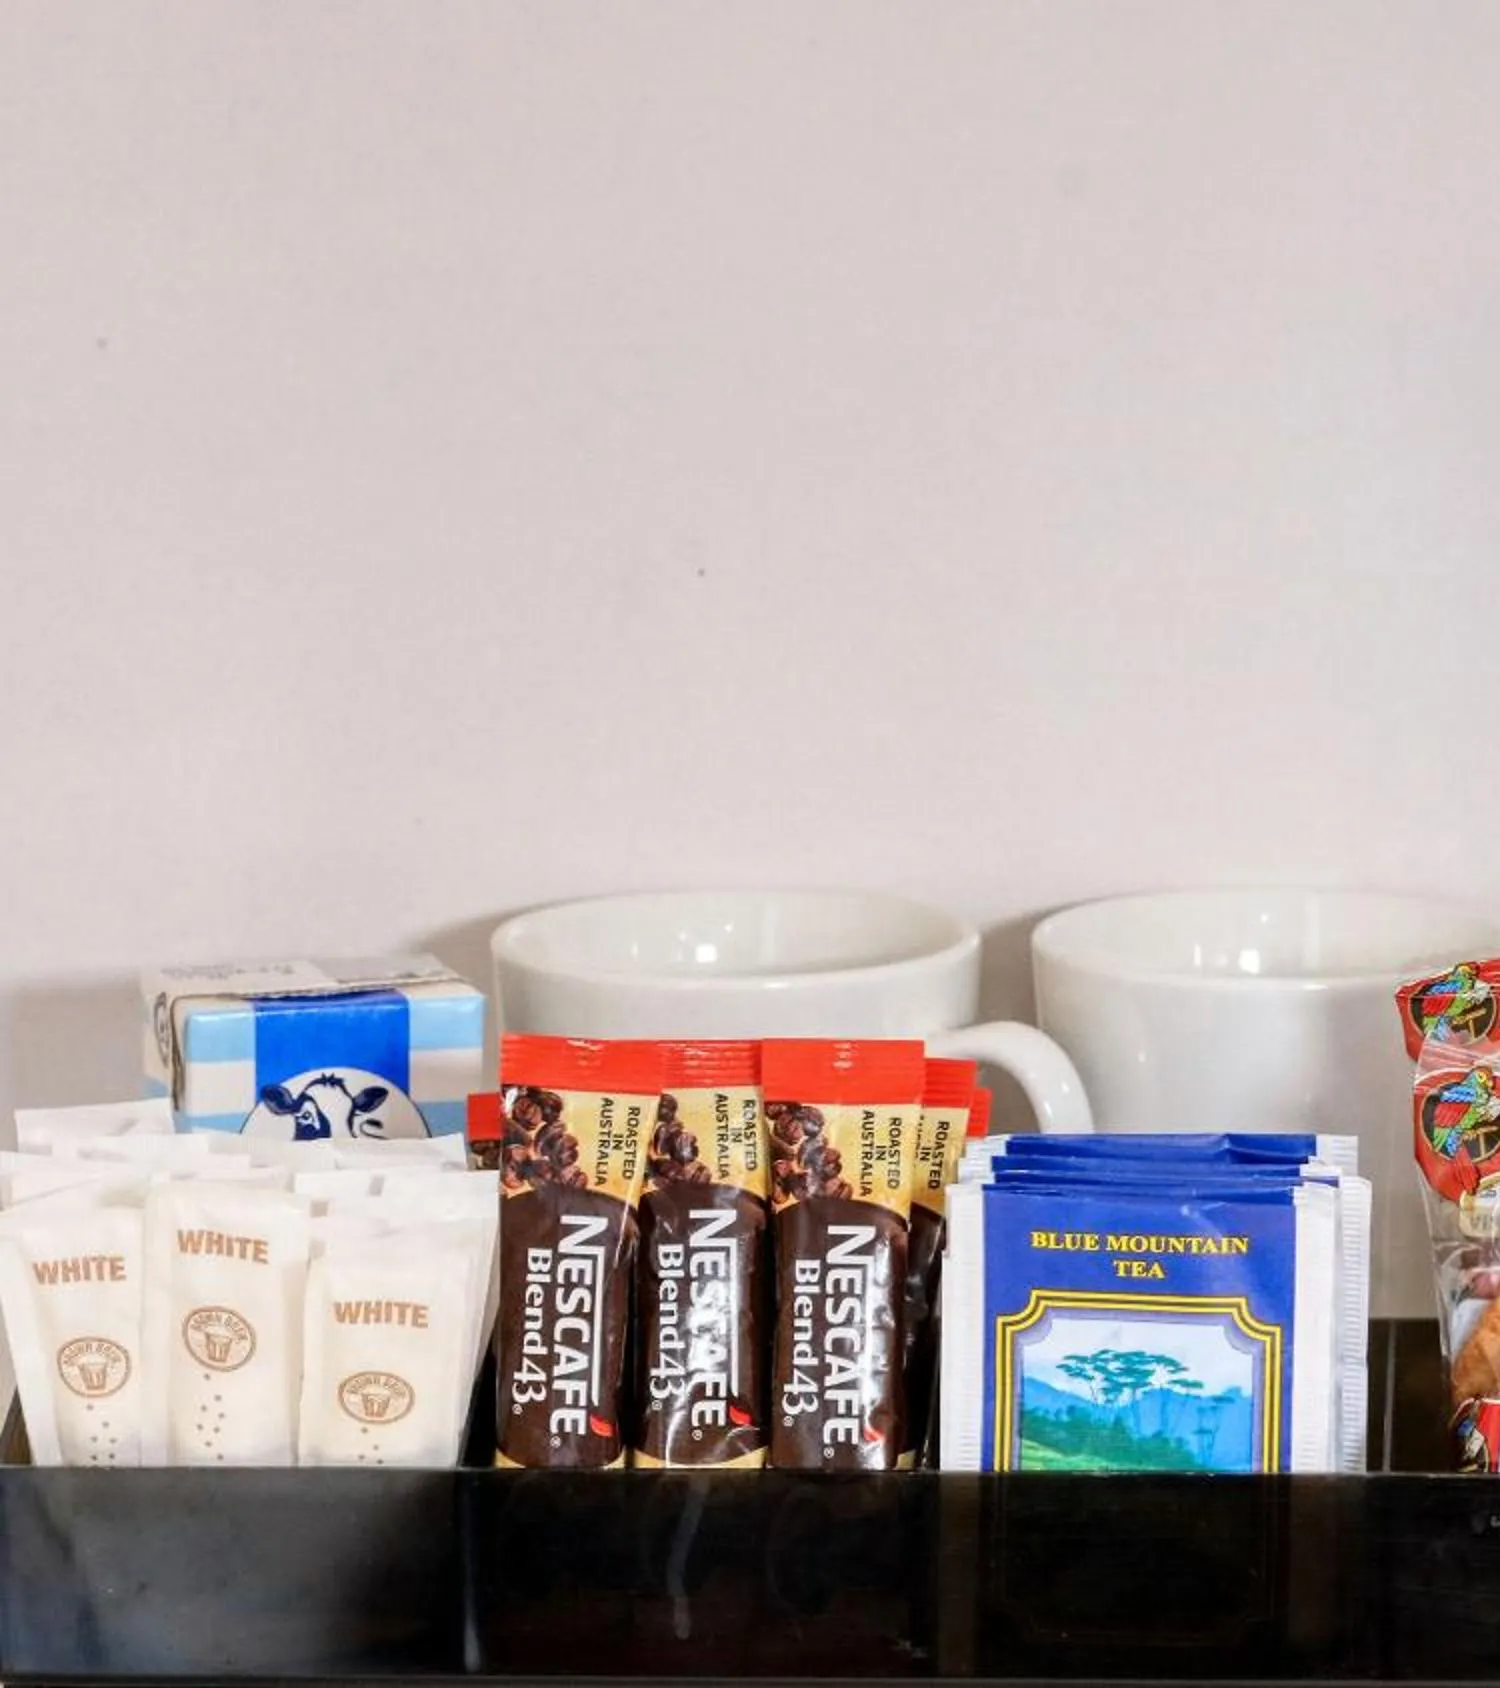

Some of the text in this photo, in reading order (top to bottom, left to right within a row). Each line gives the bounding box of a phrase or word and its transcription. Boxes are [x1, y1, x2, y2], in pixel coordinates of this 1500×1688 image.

[594, 1097, 614, 1187] AUSTRALIA
[611, 1133, 625, 1151] IN
[621, 1105, 641, 1180] ROASTED
[714, 1092, 730, 1180] AUSTRALIA
[731, 1127, 744, 1144] IN
[742, 1099, 759, 1172] ROASTED
[860, 1109, 876, 1197] AUSTRALIA
[875, 1145, 887, 1161] IN
[885, 1116, 902, 1190] ROASTED
[919, 1146, 932, 1161] IN
[928, 1121, 950, 1189] ROASTED
[177, 1228, 269, 1265] WHITE
[1030, 1231, 1249, 1255] BLUE MOUNTAIN
[33, 1255, 127, 1286] WHITE
[1113, 1259, 1165, 1279] TEA
[334, 1301, 430, 1329] WHITE
